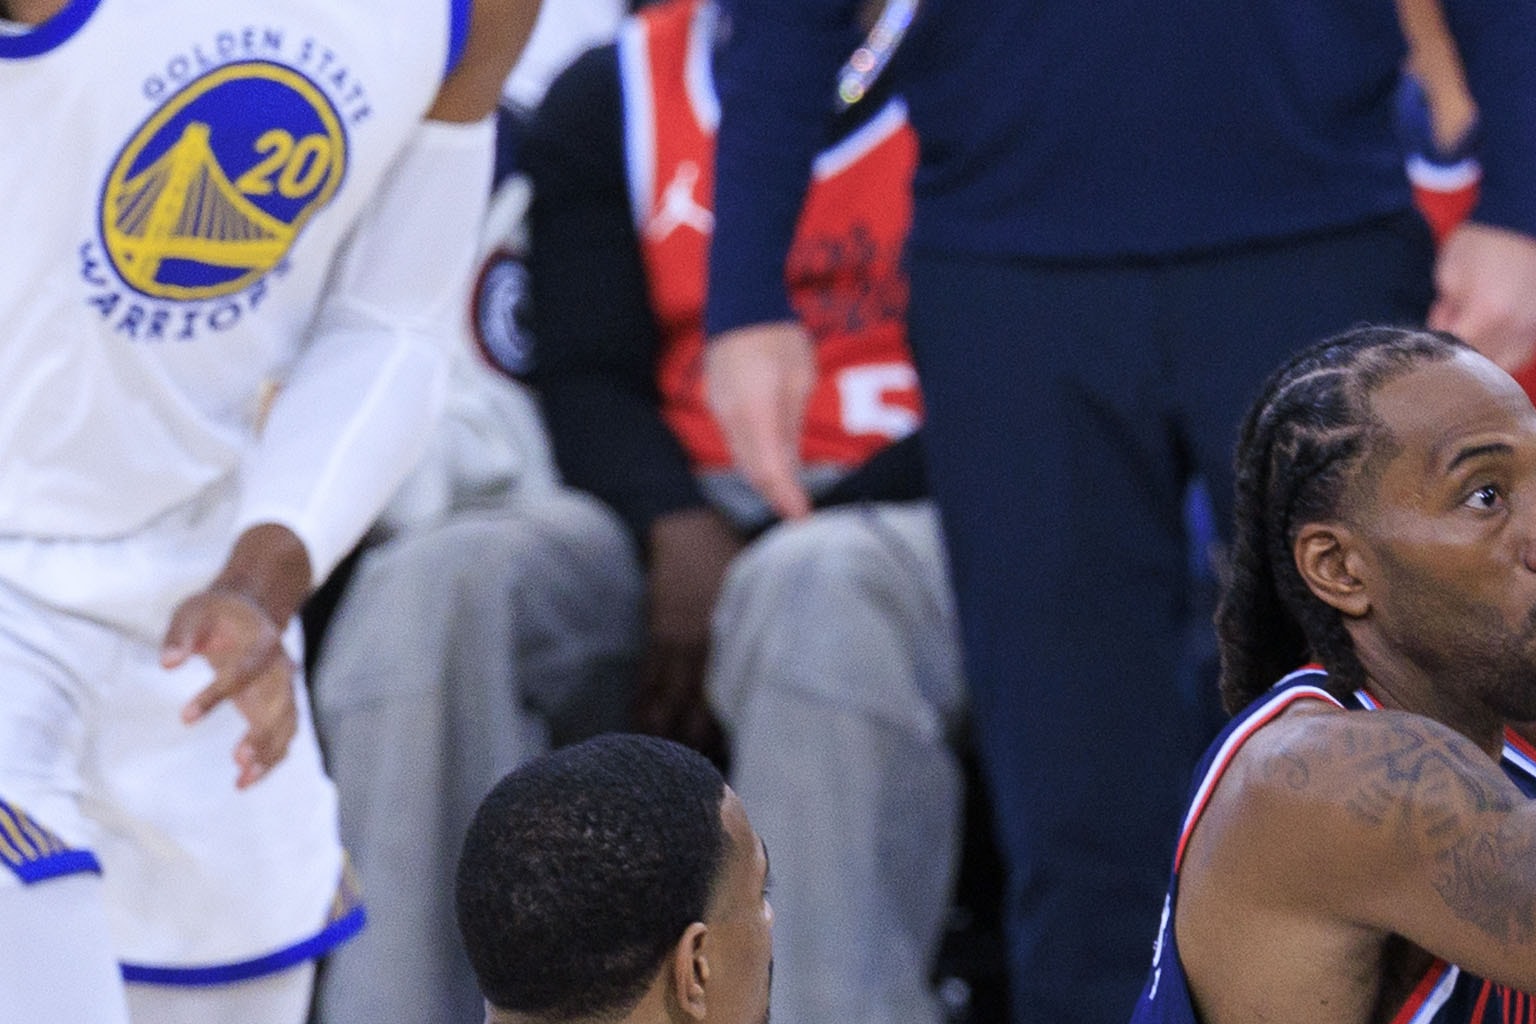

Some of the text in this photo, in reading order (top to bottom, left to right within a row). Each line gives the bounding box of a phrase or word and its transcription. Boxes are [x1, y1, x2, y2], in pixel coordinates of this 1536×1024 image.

[142, 26, 373, 125] GOLDEN STATE
[234, 127, 331, 199] 20
